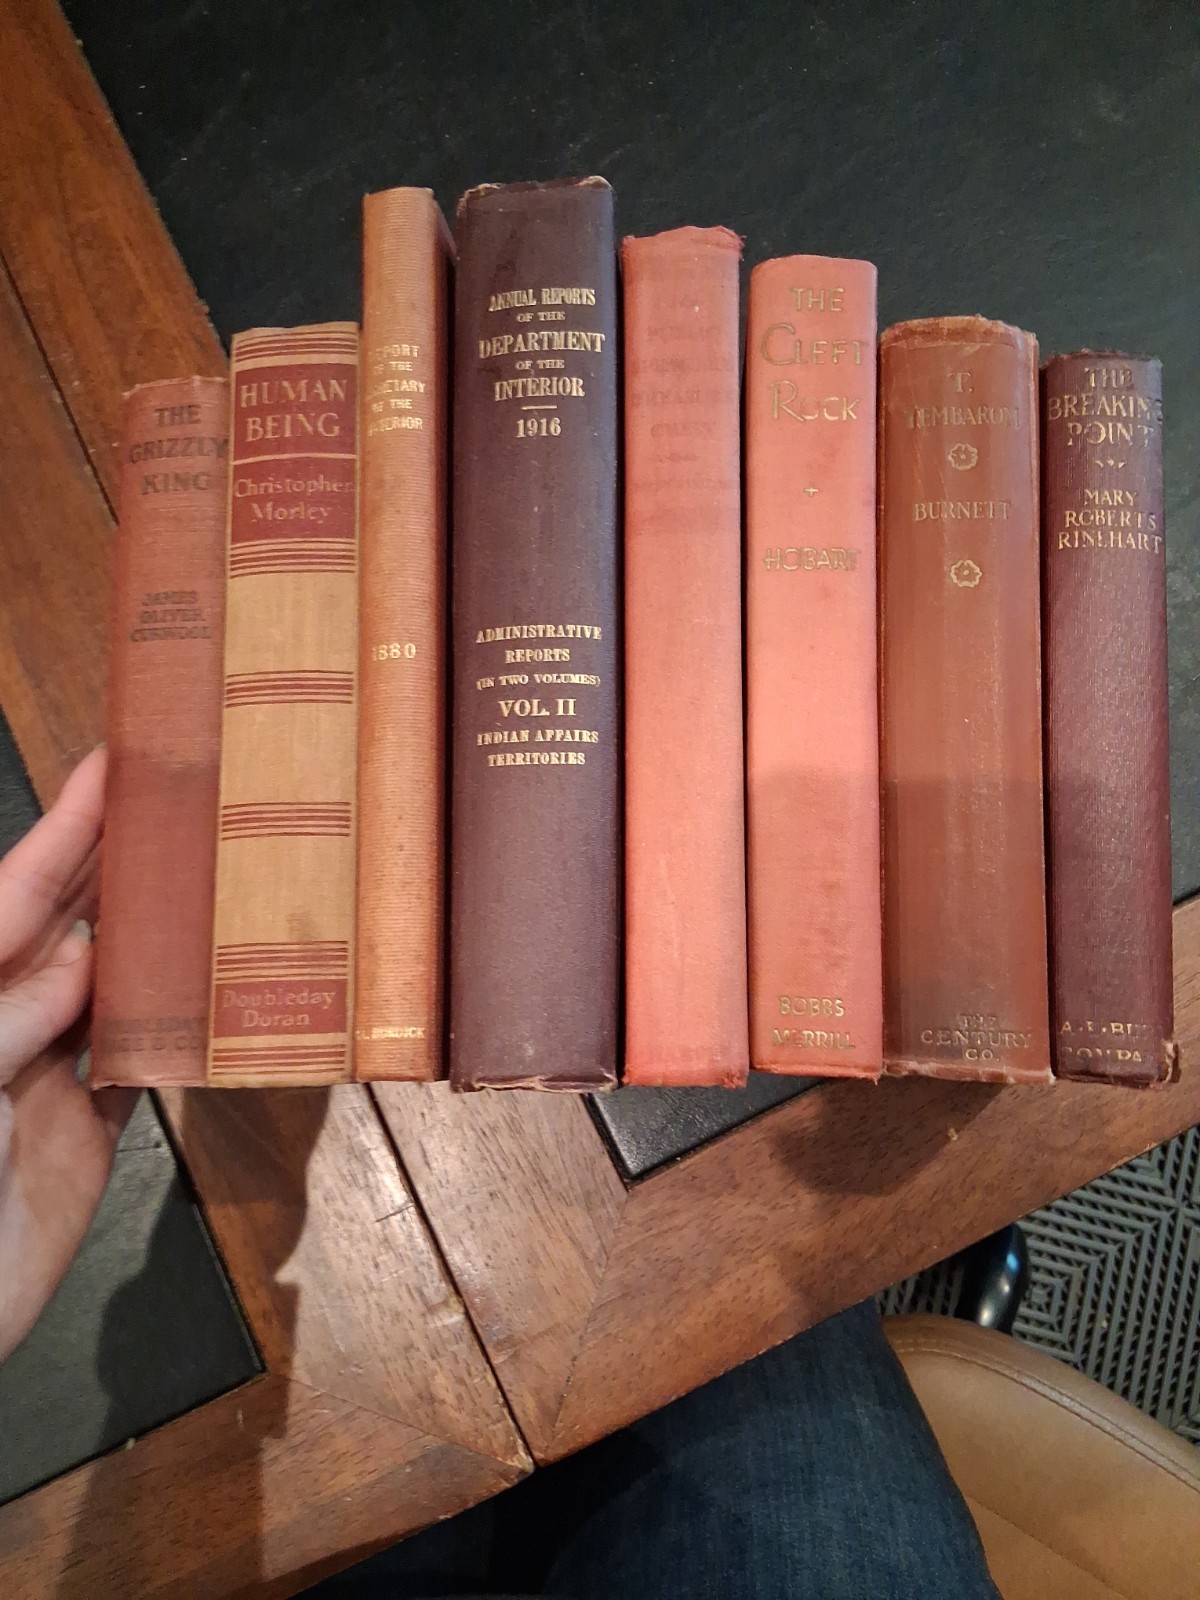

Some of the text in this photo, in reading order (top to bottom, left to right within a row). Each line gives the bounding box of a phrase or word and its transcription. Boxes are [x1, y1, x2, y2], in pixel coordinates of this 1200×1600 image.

[488, 287, 596, 312] ANNUAL REPORTS
[790, 286, 845, 312] THE
[516, 311, 566, 323] OF THE
[478, 331, 606, 359] DEPARTMENT
[760, 322, 869, 366] CLEFT
[389, 361, 413, 371] THE
[515, 359, 565, 370] OF THE
[493, 376, 586, 402] INTERIOR
[950, 371, 975, 393] T.
[1084, 367, 1135, 389] THE
[240, 379, 347, 408] HUMAN
[390, 399, 412, 409] THE
[768, 379, 860, 422] ROCK
[154, 405, 201, 427] THE
[1048, 394, 1163, 422] BREAKIN
[246, 413, 340, 442] BEING
[516, 417, 562, 438] 1916
[1067, 421, 1154, 448] POINT
[130, 436, 230, 464] GRIZZLY
[141, 472, 209, 495] KING
[234, 474, 354, 498] Christopher
[1084, 488, 1138, 507] MARY
[251, 501, 332, 523] Morley
[914, 500, 1012, 521] BURNETT
[1065, 510, 1157, 533] ROBERTS
[1058, 530, 1162, 554] RINEHART
[764, 547, 862, 571] HOBART
[475, 624, 602, 644] ADMINISTRATIVE
[371, 643, 416, 661] 1880
[505, 648, 570, 664] REPORTS
[476, 673, 601, 691] (IN TWO VOLUMES)
[498, 698, 577, 718] VOL. II
[477, 729, 599, 746] INDIAN AFFAIRS
[487, 752, 586, 767] TERRITORIES
[223, 987, 336, 1009] Doubleday
[243, 1009, 311, 1028] Doran
[773, 1028, 855, 1049] MERRILL
[920, 1028, 1032, 1049] CENTURY
[965, 1048, 1000, 1062] CO.
